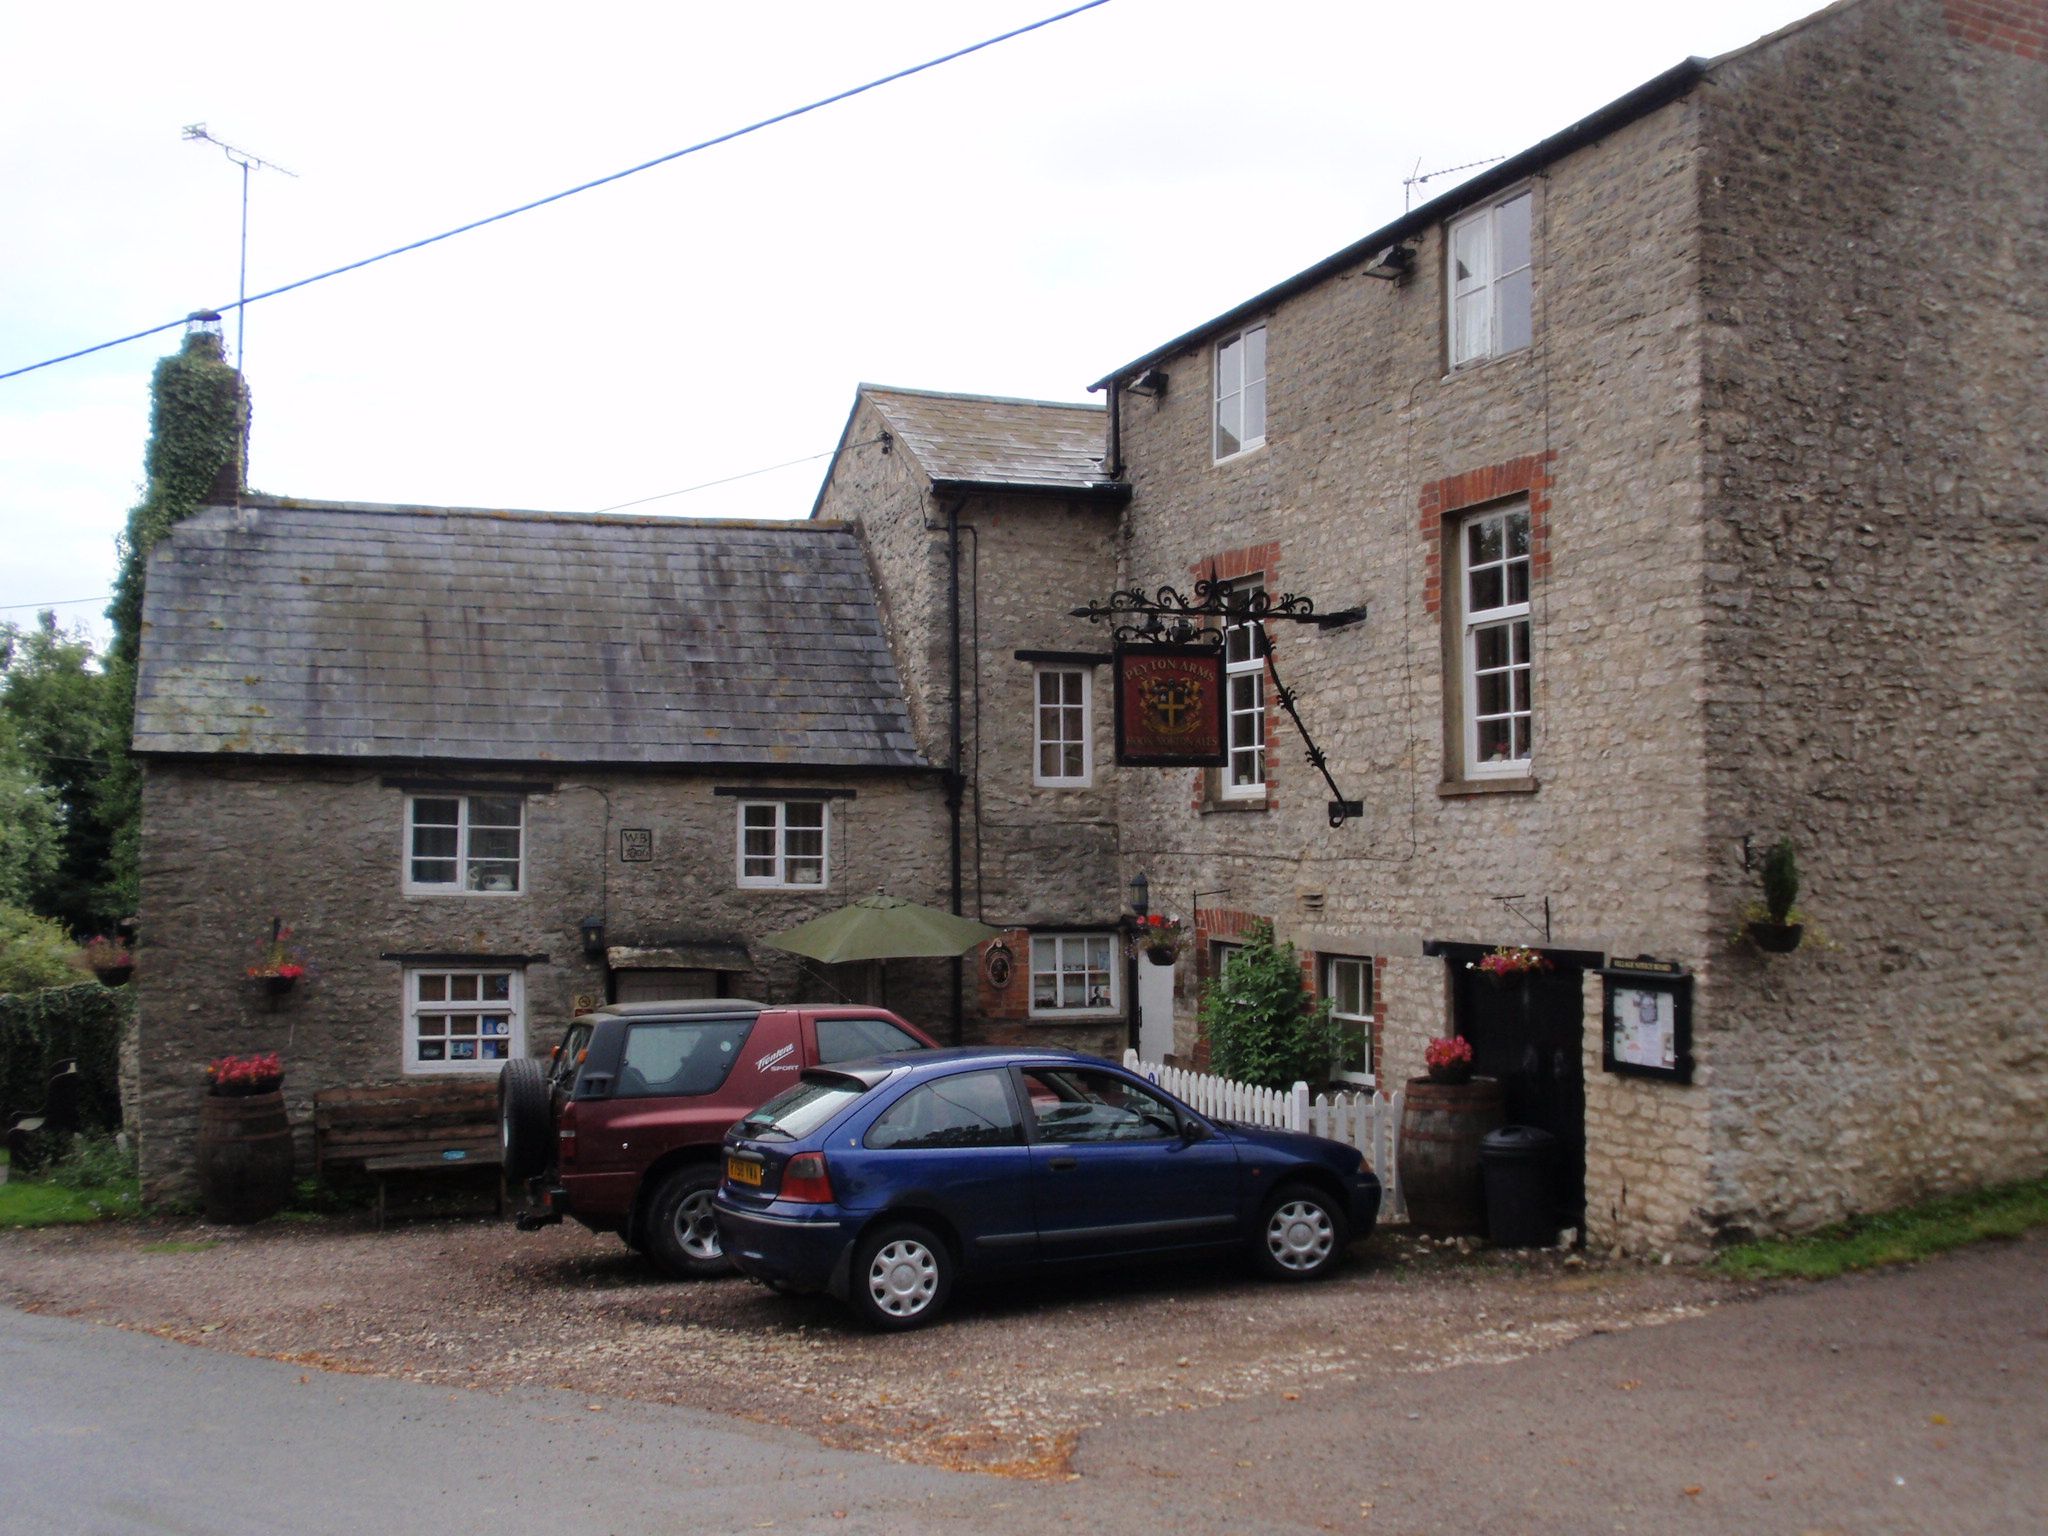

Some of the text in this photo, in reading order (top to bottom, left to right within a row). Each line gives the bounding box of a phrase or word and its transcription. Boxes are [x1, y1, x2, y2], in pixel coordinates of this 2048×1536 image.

[1125, 659, 1215, 682] PEYTON ARMS
[1195, 735, 1217, 746] ALES
[770, 1064, 799, 1072] SPORT
